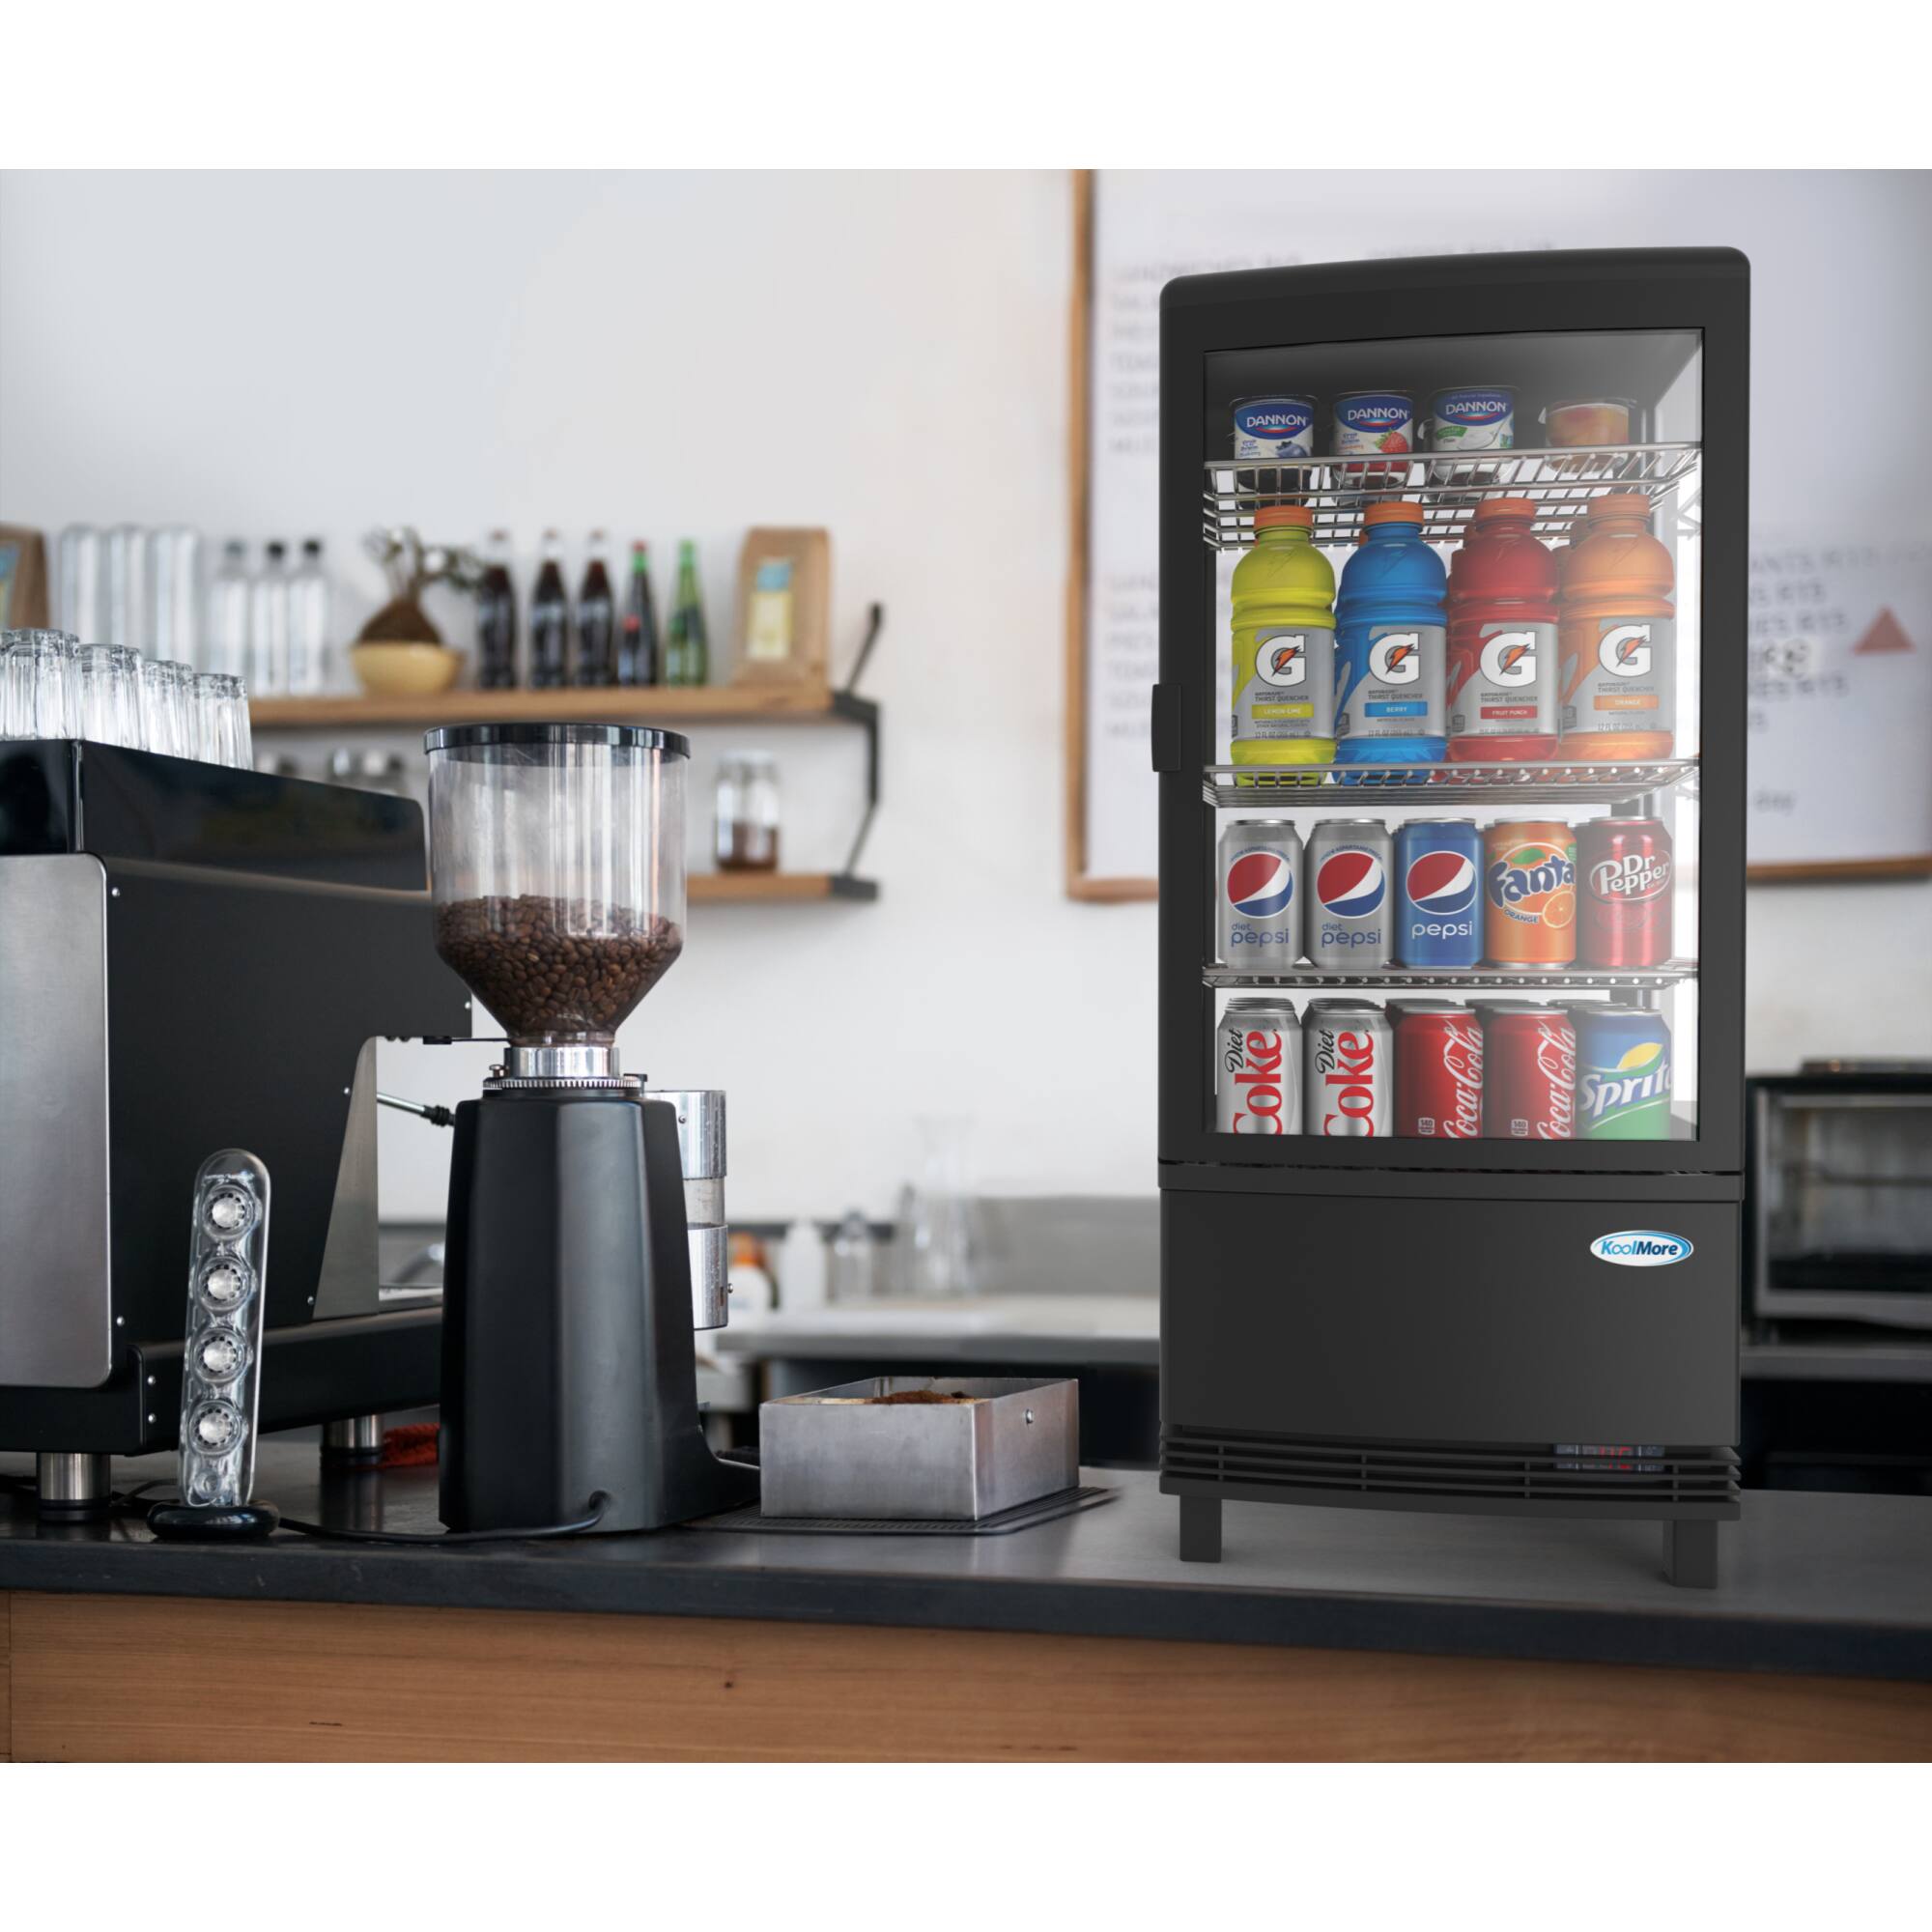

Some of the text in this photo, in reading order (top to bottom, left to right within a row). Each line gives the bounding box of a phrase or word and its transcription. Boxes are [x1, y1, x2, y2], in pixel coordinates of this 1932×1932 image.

[1348, 408, 1407, 421] DANNON
[1445, 401, 1506, 415] DANNON
[1246, 414, 1306, 428] DANNON
[1256, 634, 1307, 687] G
[1369, 633, 1421, 685] G
[1480, 631, 1537, 688] G
[1598, 624, 1652, 677] G
[1623, 854, 1656, 876] Dr
[1488, 854, 1577, 909] Fanta
[1591, 860, 1669, 895] Pepper
[1504, 909, 1540, 923] ORANGE
[1321, 923, 1343, 931] diet
[1411, 921, 1473, 939] pepsi
[1231, 928, 1289, 948] pepsi
[1321, 928, 1381, 948] pepsi
[1225, 1028, 1244, 1073] Diet
[1315, 1028, 1335, 1074] Diet
[1601, 1240, 1679, 1256] KoolMore
